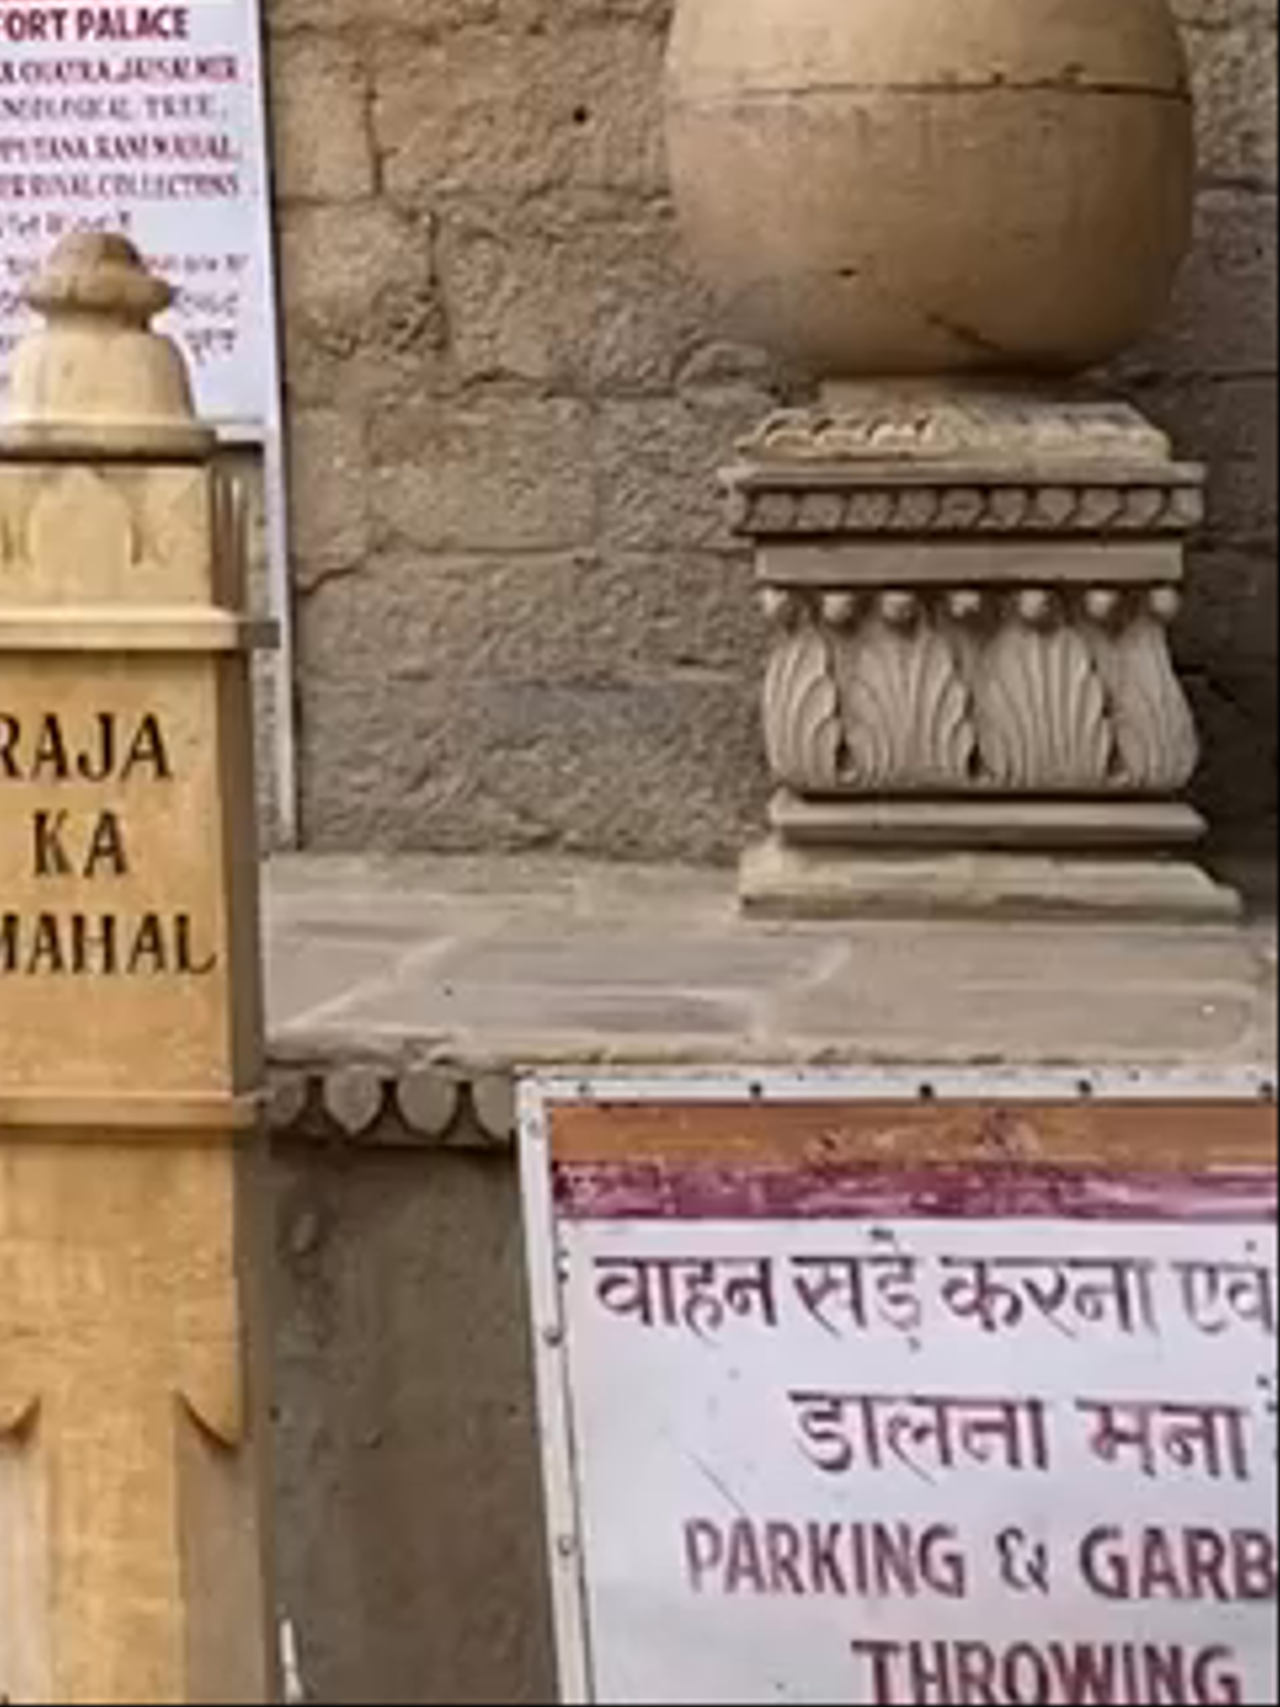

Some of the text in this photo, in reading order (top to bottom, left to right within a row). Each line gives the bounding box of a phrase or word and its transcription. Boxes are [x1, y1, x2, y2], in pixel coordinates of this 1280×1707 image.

[76, 5, 190, 40] PALACE
[33, 809, 130, 878] KA
[594, 1255, 778, 1347] वाहन
[940, 1255, 1158, 1339] करना
[1074, 1396, 1252, 1481] मना
[685, 1520, 966, 1600] PARKING
[995, 1527, 1050, 1594] &
[850, 1639, 1244, 1705] THROWING
